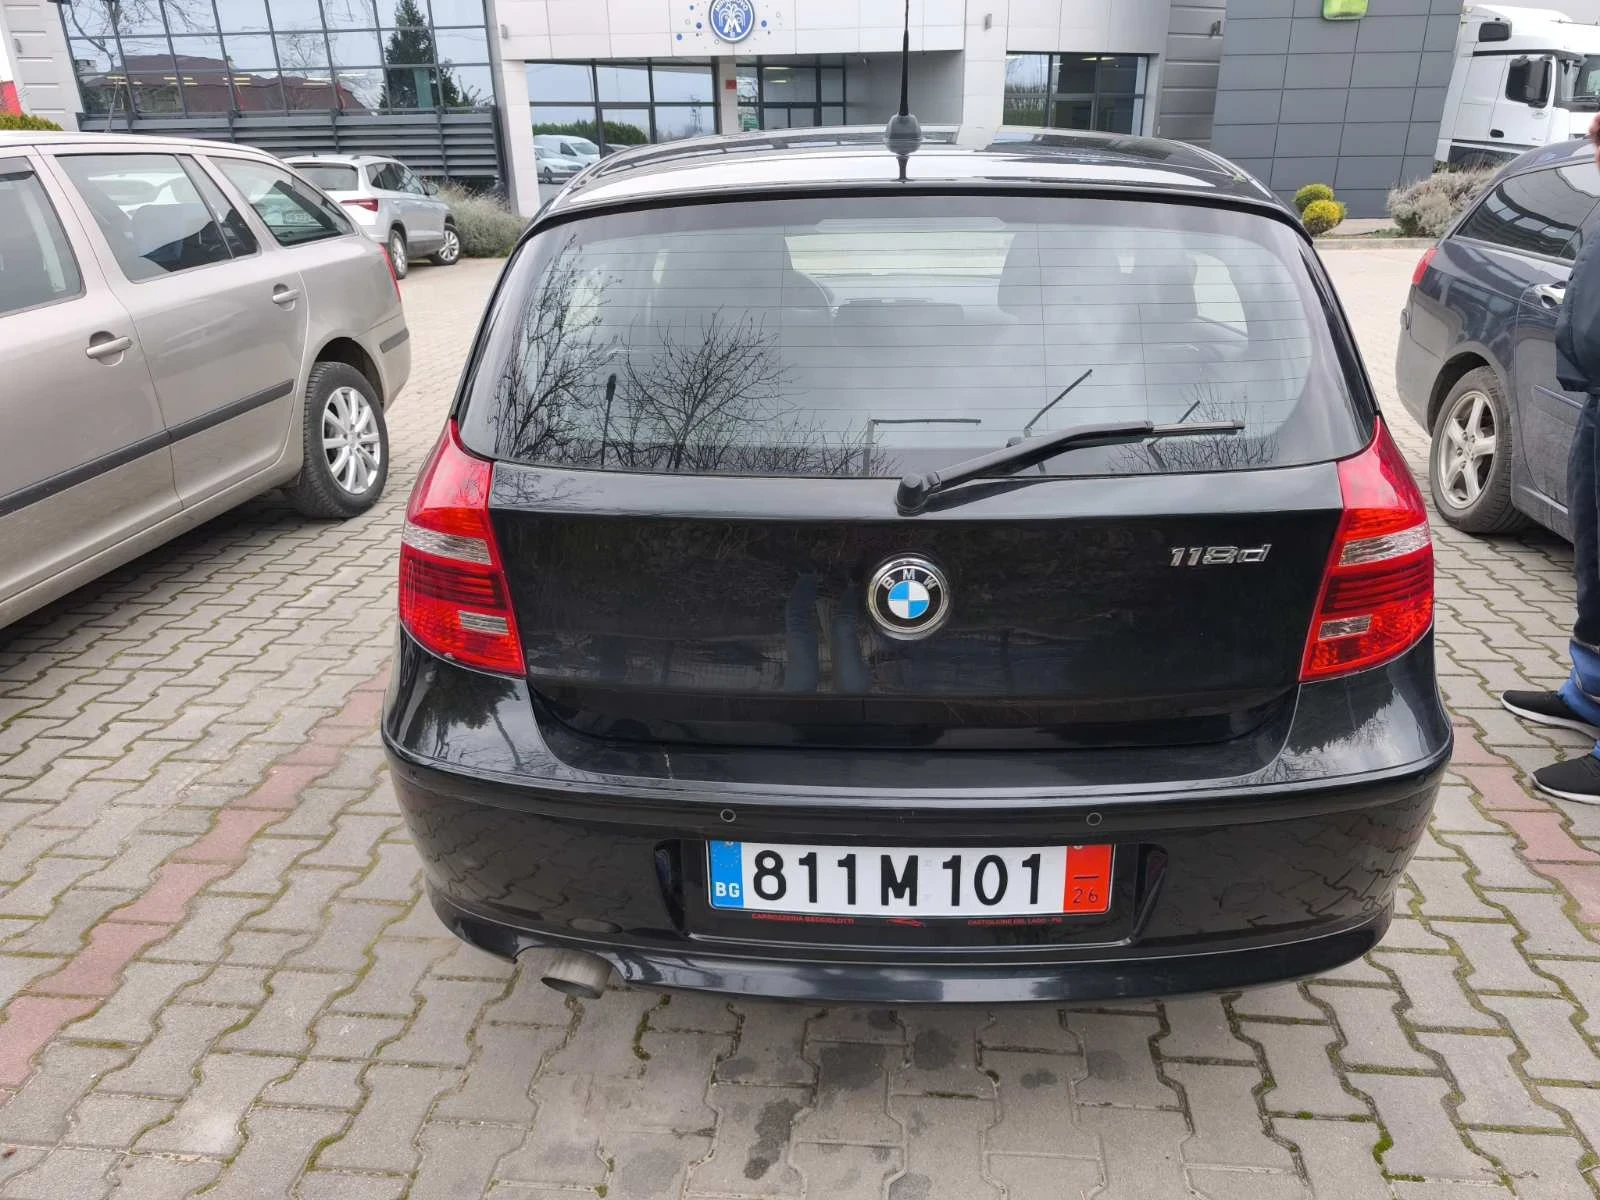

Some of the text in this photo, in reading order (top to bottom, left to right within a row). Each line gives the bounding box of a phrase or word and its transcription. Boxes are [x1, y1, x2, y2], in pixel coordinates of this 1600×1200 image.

[1170, 544, 1272, 566] 118d
[880, 568, 938, 590] BMW
[715, 882, 740, 897] BG
[753, 850, 1041, 907] 811 M 101
[1073, 888, 1098, 904] 26
